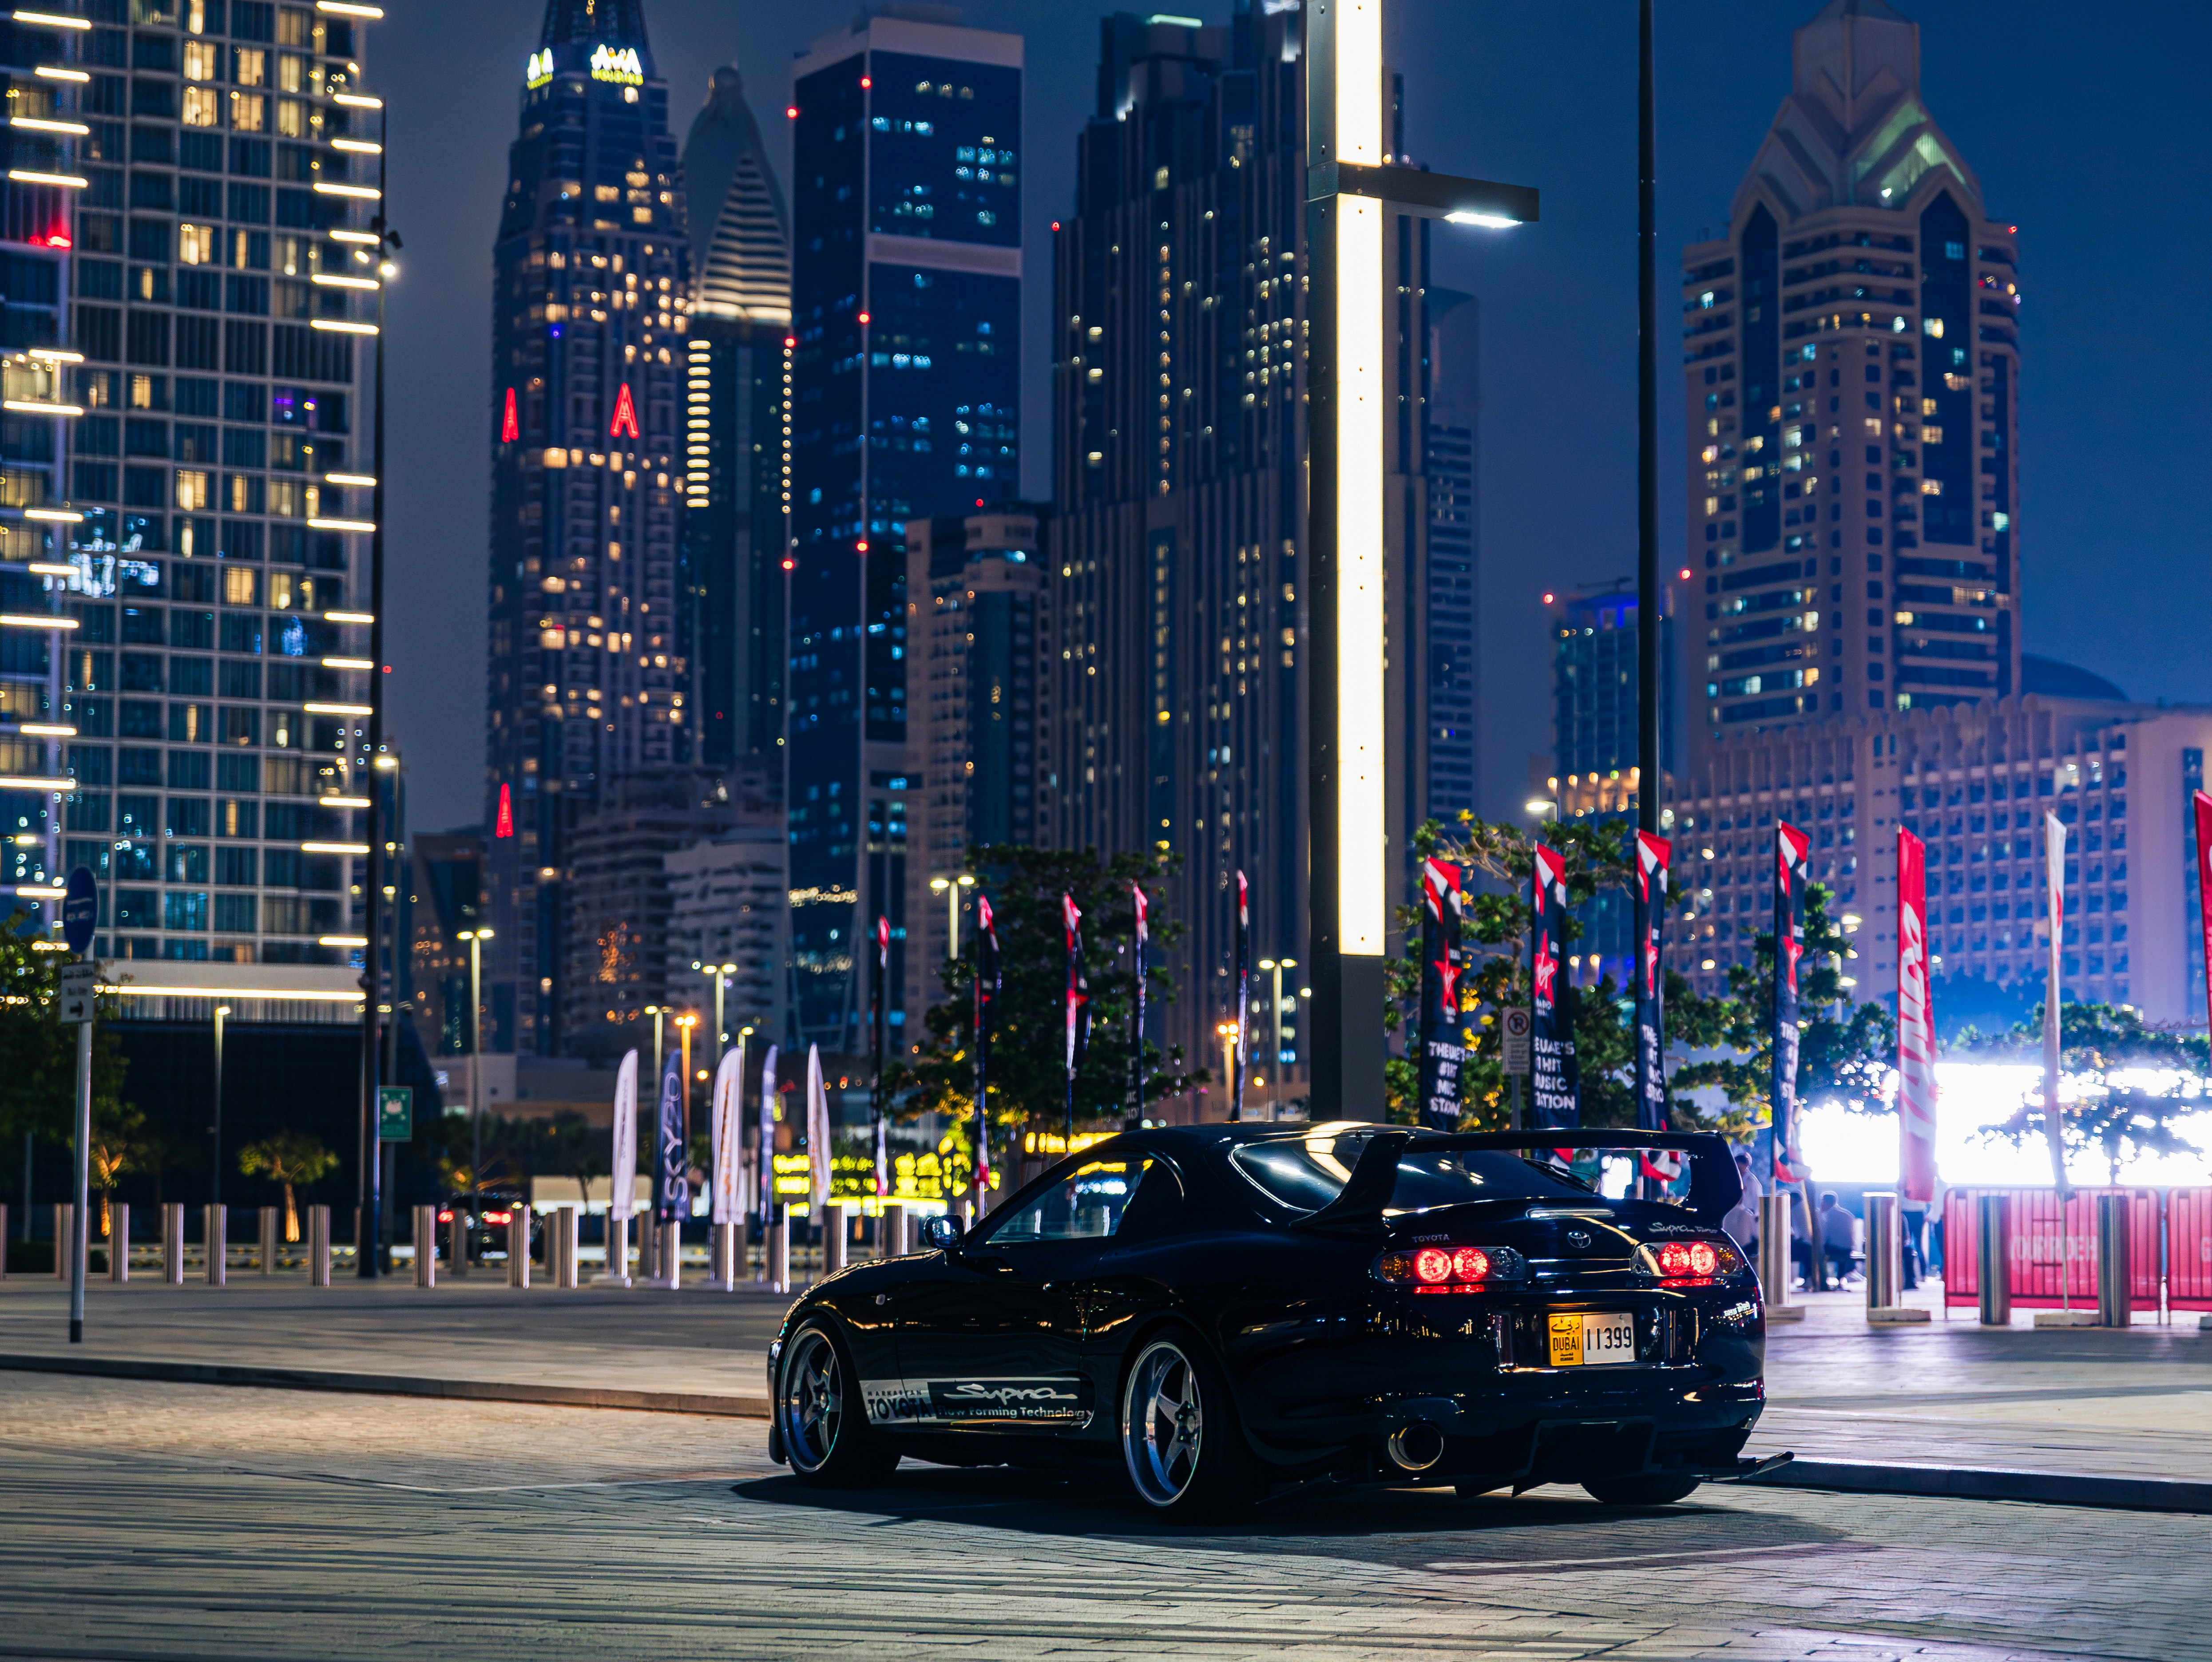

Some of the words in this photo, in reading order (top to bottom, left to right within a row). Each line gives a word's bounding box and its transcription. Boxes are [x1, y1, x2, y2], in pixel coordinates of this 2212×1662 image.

[1412, 1234, 1450, 1243] TOYOTA
[1553, 1336, 1579, 1351] DUBAI
[1587, 1326, 1632, 1350] 11399
[943, 1384, 1078, 1405] Supra
[868, 1398, 932, 1420] TOYOTA
[938, 1406, 965, 1416] Flow
[970, 1406, 1017, 1418] Forming
[1020, 1407, 1093, 1421] Technology
